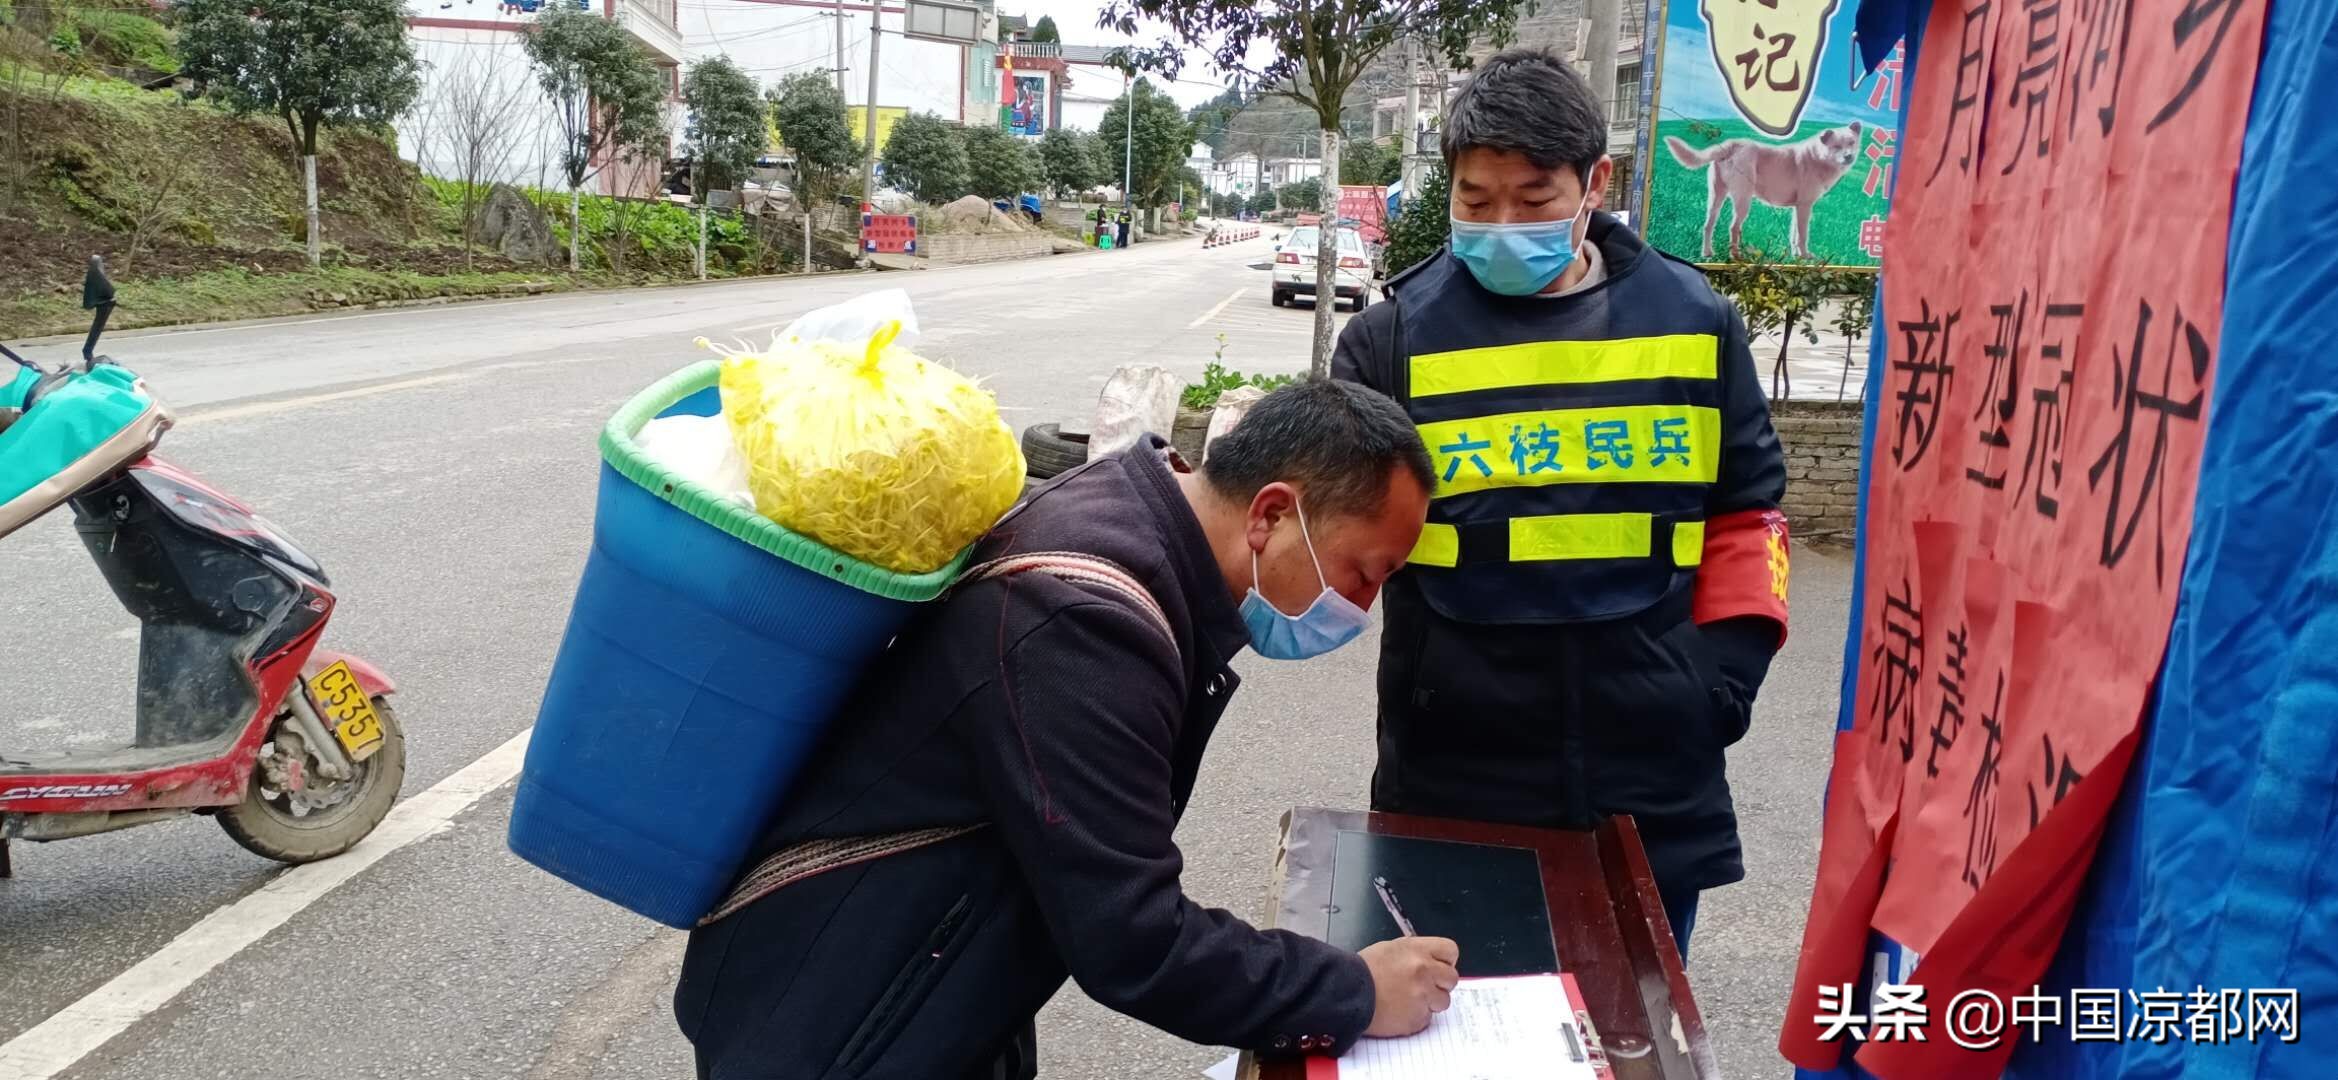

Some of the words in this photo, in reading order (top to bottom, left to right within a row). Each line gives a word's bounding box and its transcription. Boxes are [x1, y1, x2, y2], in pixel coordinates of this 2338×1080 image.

[1735, 0, 1800, 92] 记
[1438, 416, 1691, 483] 六枝民兵
[1888, 288, 2213, 591] 新型冠状
[320, 668, 384, 750] C5357
[1870, 577, 2083, 893] 病毒检
